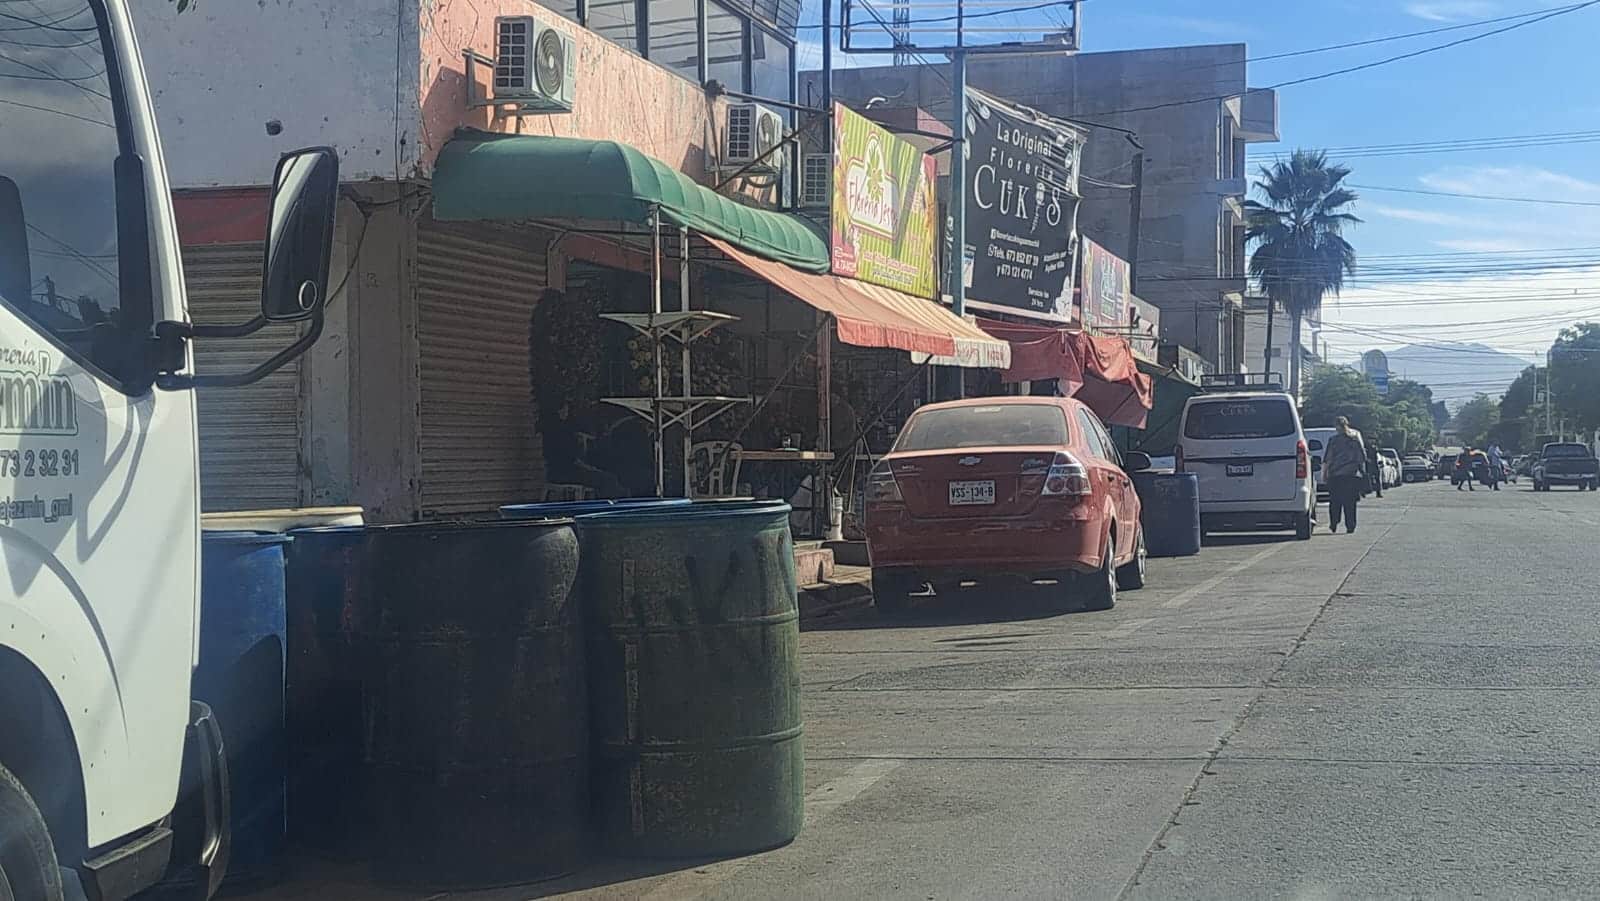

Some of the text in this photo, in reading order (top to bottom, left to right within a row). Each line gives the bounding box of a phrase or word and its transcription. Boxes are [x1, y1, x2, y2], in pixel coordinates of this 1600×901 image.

[997, 122, 1051, 157] La Original
[24, 449, 35, 477] 2
[39, 449, 58, 477] 32
[62, 449, 79, 475] 31
